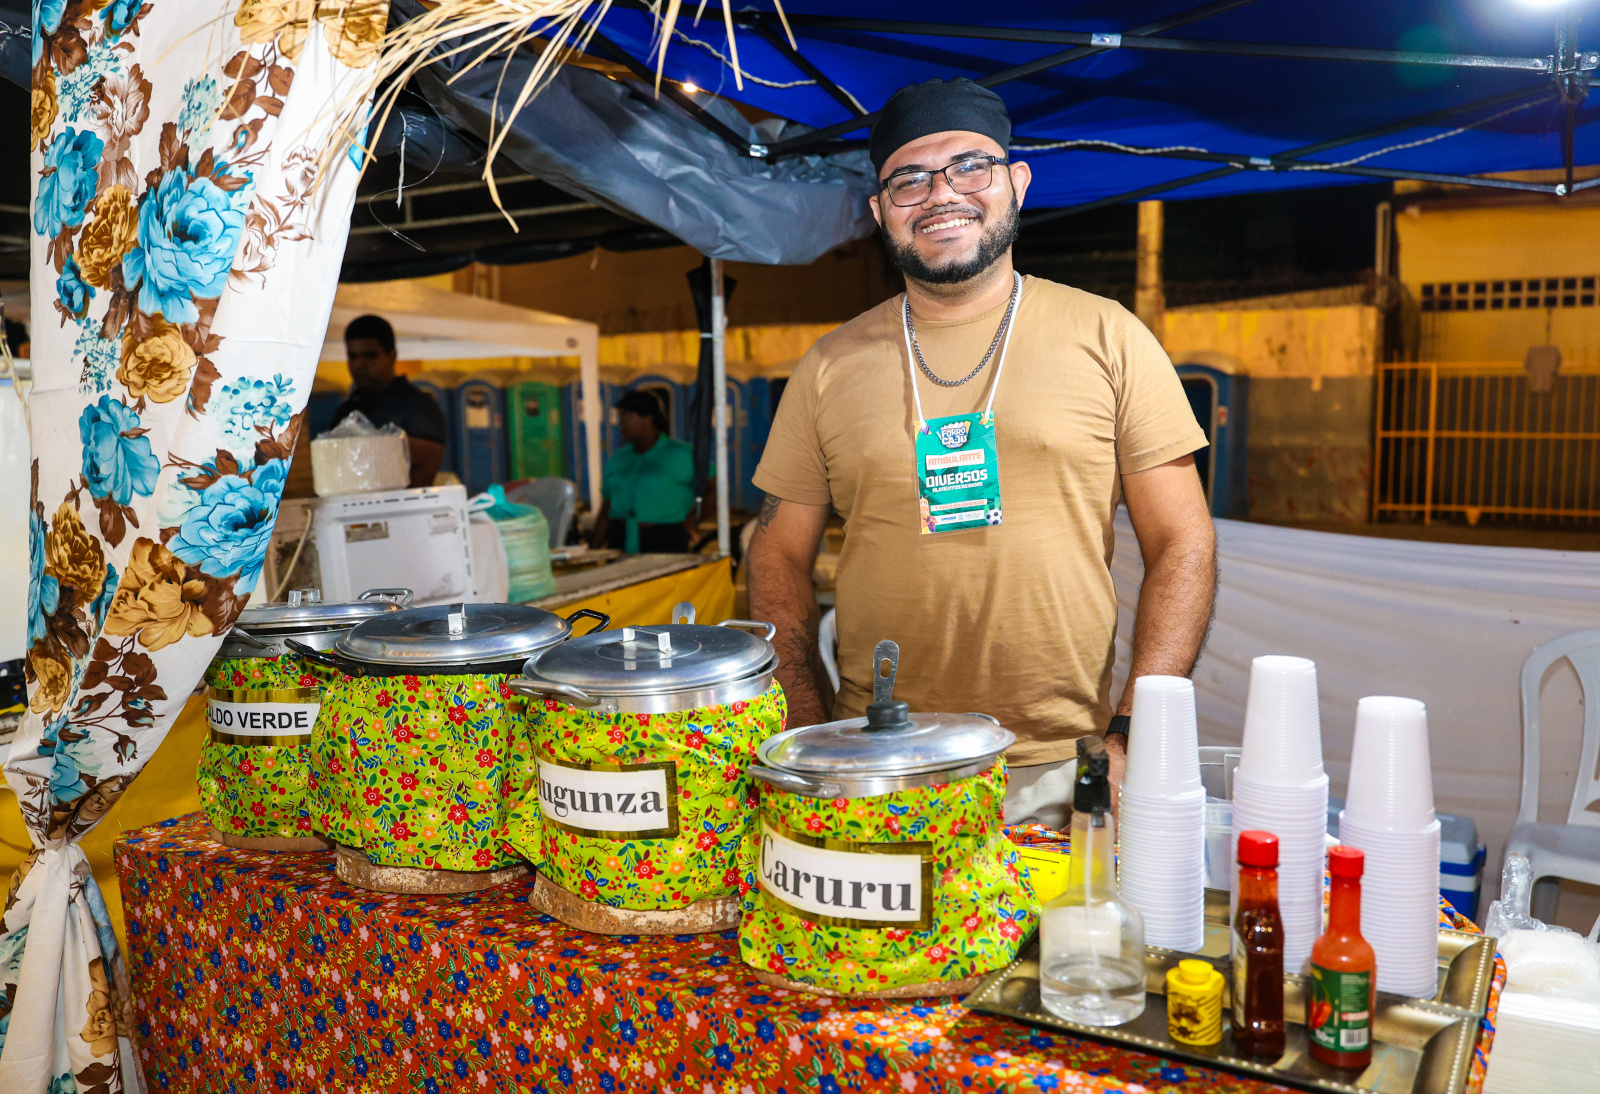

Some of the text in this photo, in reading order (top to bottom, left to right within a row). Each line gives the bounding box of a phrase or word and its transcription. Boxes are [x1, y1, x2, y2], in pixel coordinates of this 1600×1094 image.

[941, 435, 968, 446] CAJU
[928, 452, 982, 467] AMBULANTE
[926, 469, 988, 488] DIVERSOS
[237, 711, 309, 729] VERDE
[761, 833, 915, 911] Caruru
